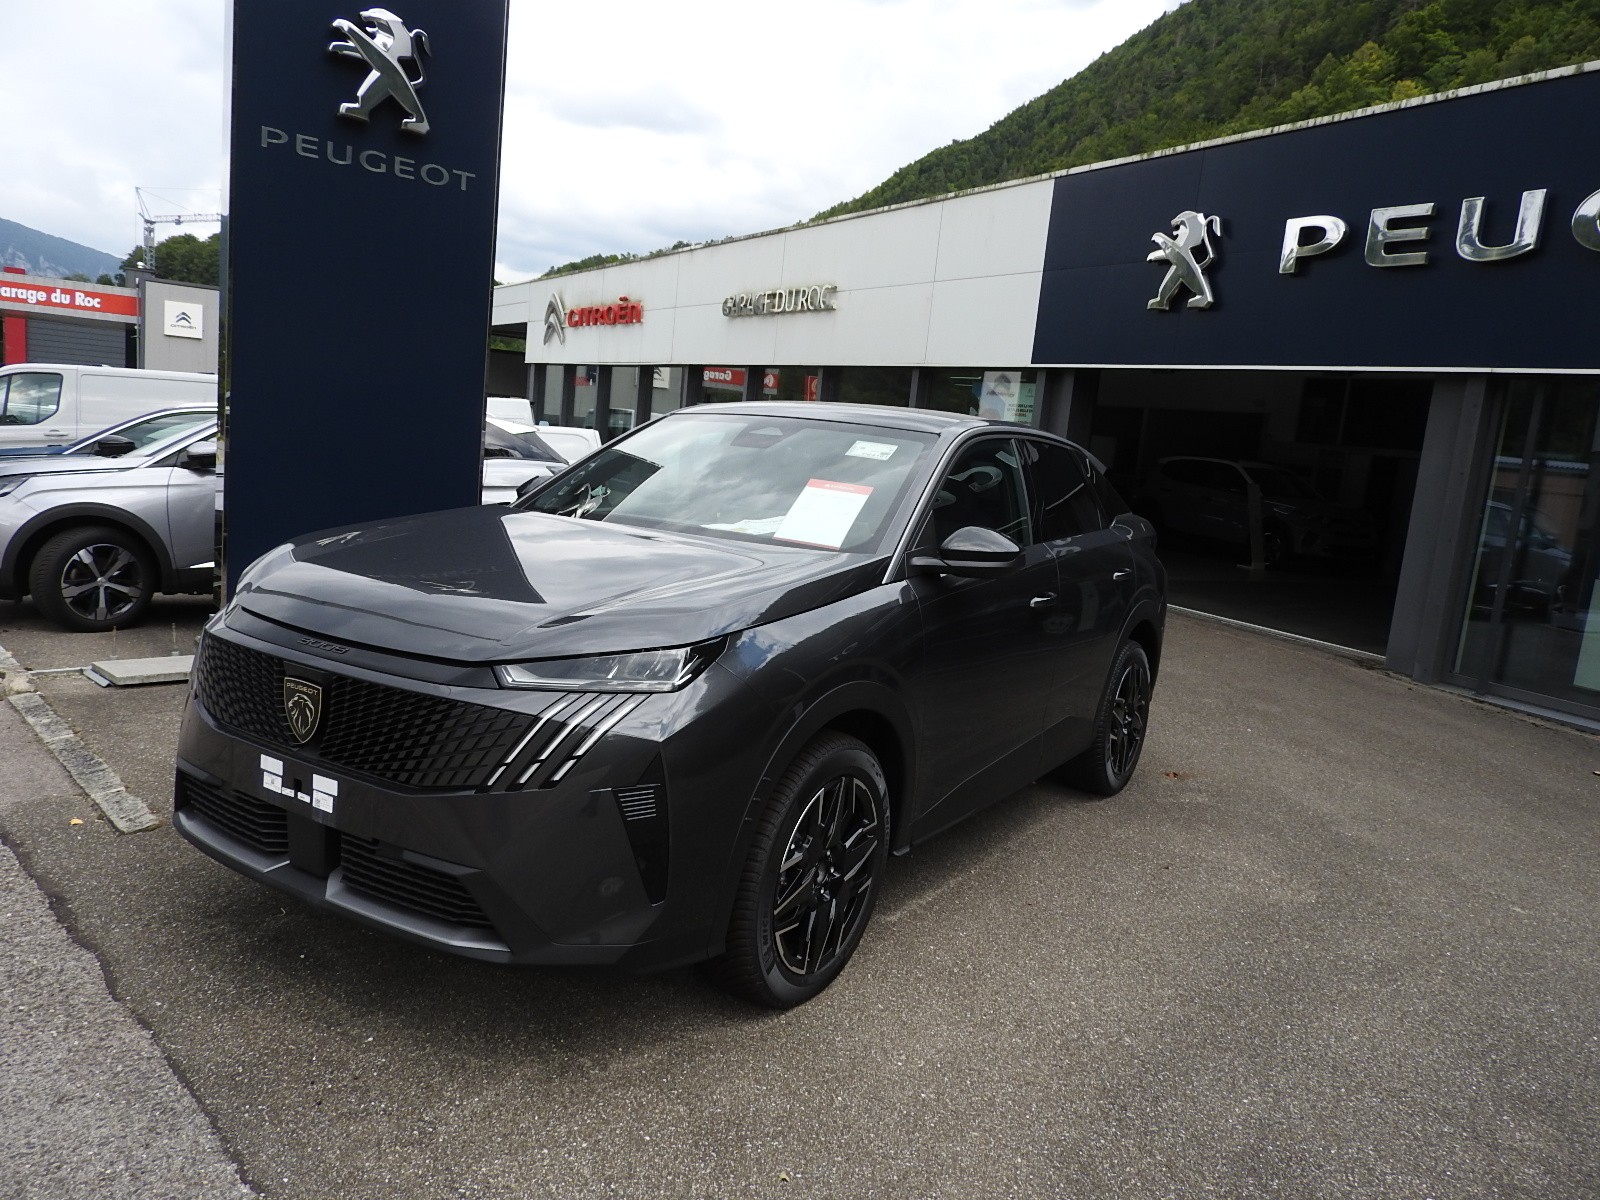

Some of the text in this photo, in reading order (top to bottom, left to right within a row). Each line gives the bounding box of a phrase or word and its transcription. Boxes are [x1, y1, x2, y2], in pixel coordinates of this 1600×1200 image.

[260, 125, 476, 191] PEUGEOT
[0, 285, 101, 308] arage du Roc
[773, 289, 795, 312] DU
[798, 284, 837, 311] ROC
[286, 682, 318, 696] PEUGEOT
